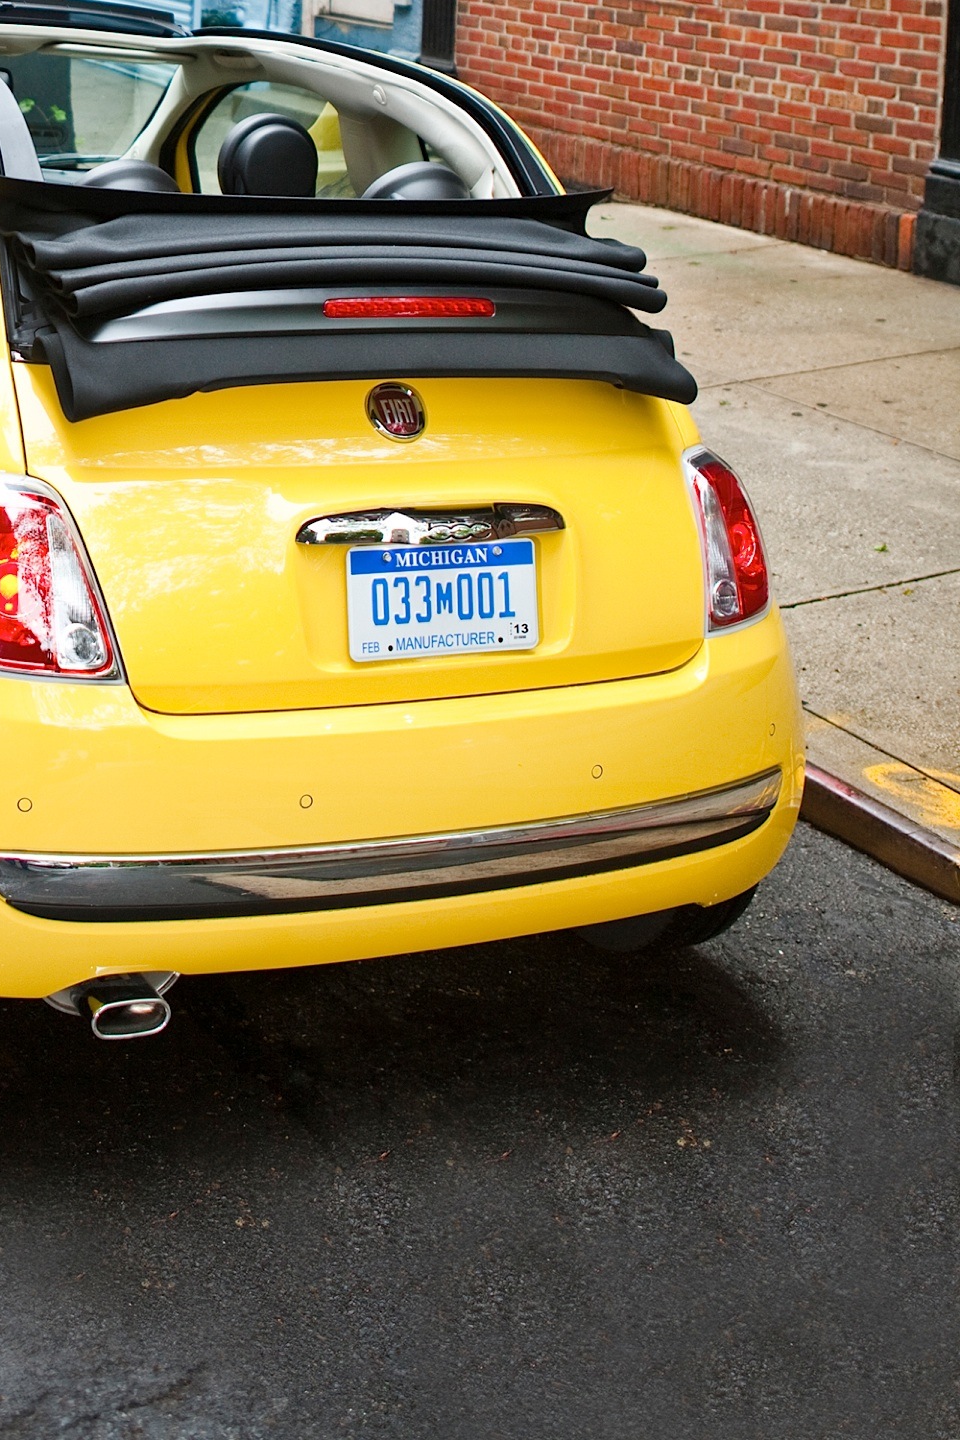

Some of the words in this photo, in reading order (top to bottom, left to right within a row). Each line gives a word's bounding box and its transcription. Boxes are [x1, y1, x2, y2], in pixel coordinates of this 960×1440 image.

[380, 399, 414, 424] FIAT
[394, 547, 488, 568] MICHIGAN
[371, 571, 516, 626] 033M001
[513, 623, 529, 634] 13
[361, 641, 380, 654] FEB
[395, 631, 495, 652] MANUFACTURER
